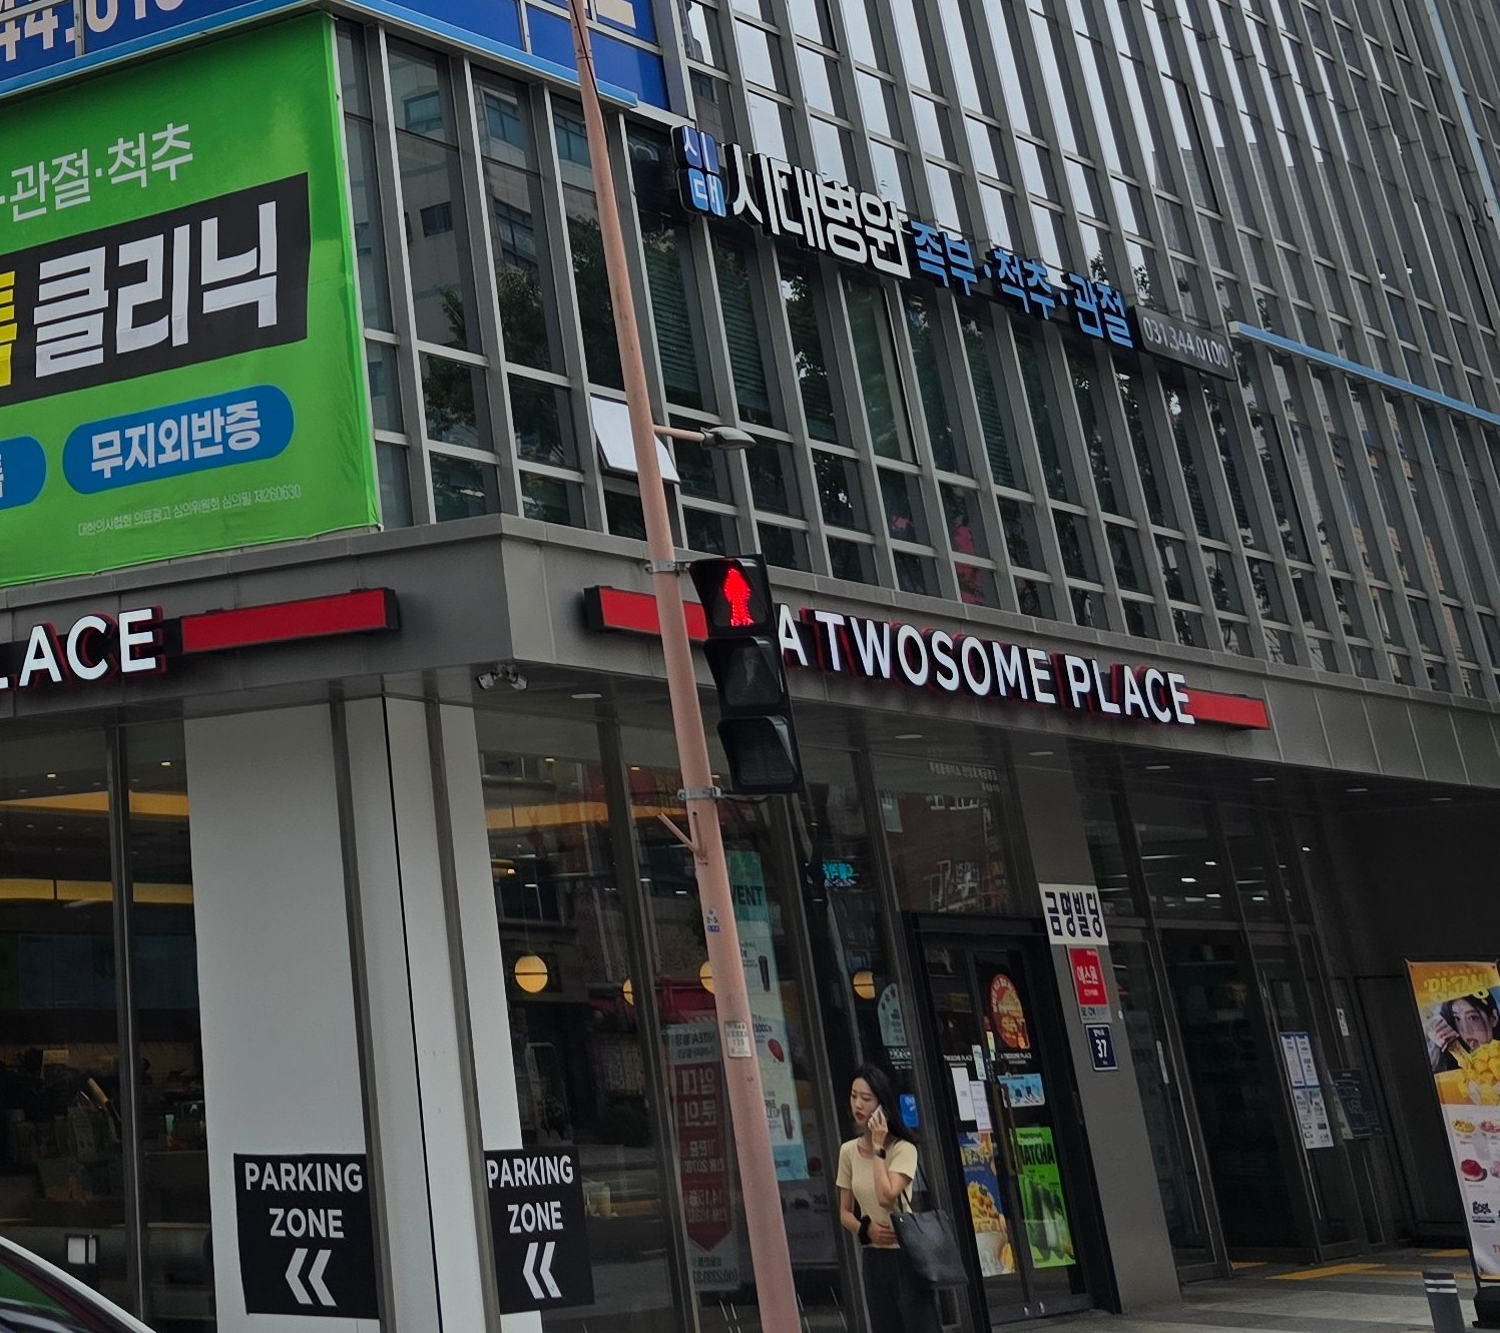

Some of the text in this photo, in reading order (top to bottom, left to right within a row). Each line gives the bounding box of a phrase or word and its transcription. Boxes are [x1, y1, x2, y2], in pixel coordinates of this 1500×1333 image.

[732, 143, 911, 280] 시대병원
[34, 200, 280, 379] 클리닉
[1141, 314, 1230, 370] 031.344.0100
[90, 398, 262, 479] 무지외반증
[778, 603, 1196, 725] A TWOSOME PLACE
[732, 885, 762, 906] VENT
[1095, 1038, 1108, 1059] 37
[244, 1161, 364, 1193] PARKING
[486, 1154, 574, 1189] PARKING
[268, 1207, 345, 1239] ZONE
[507, 1201, 564, 1234] ZONE
